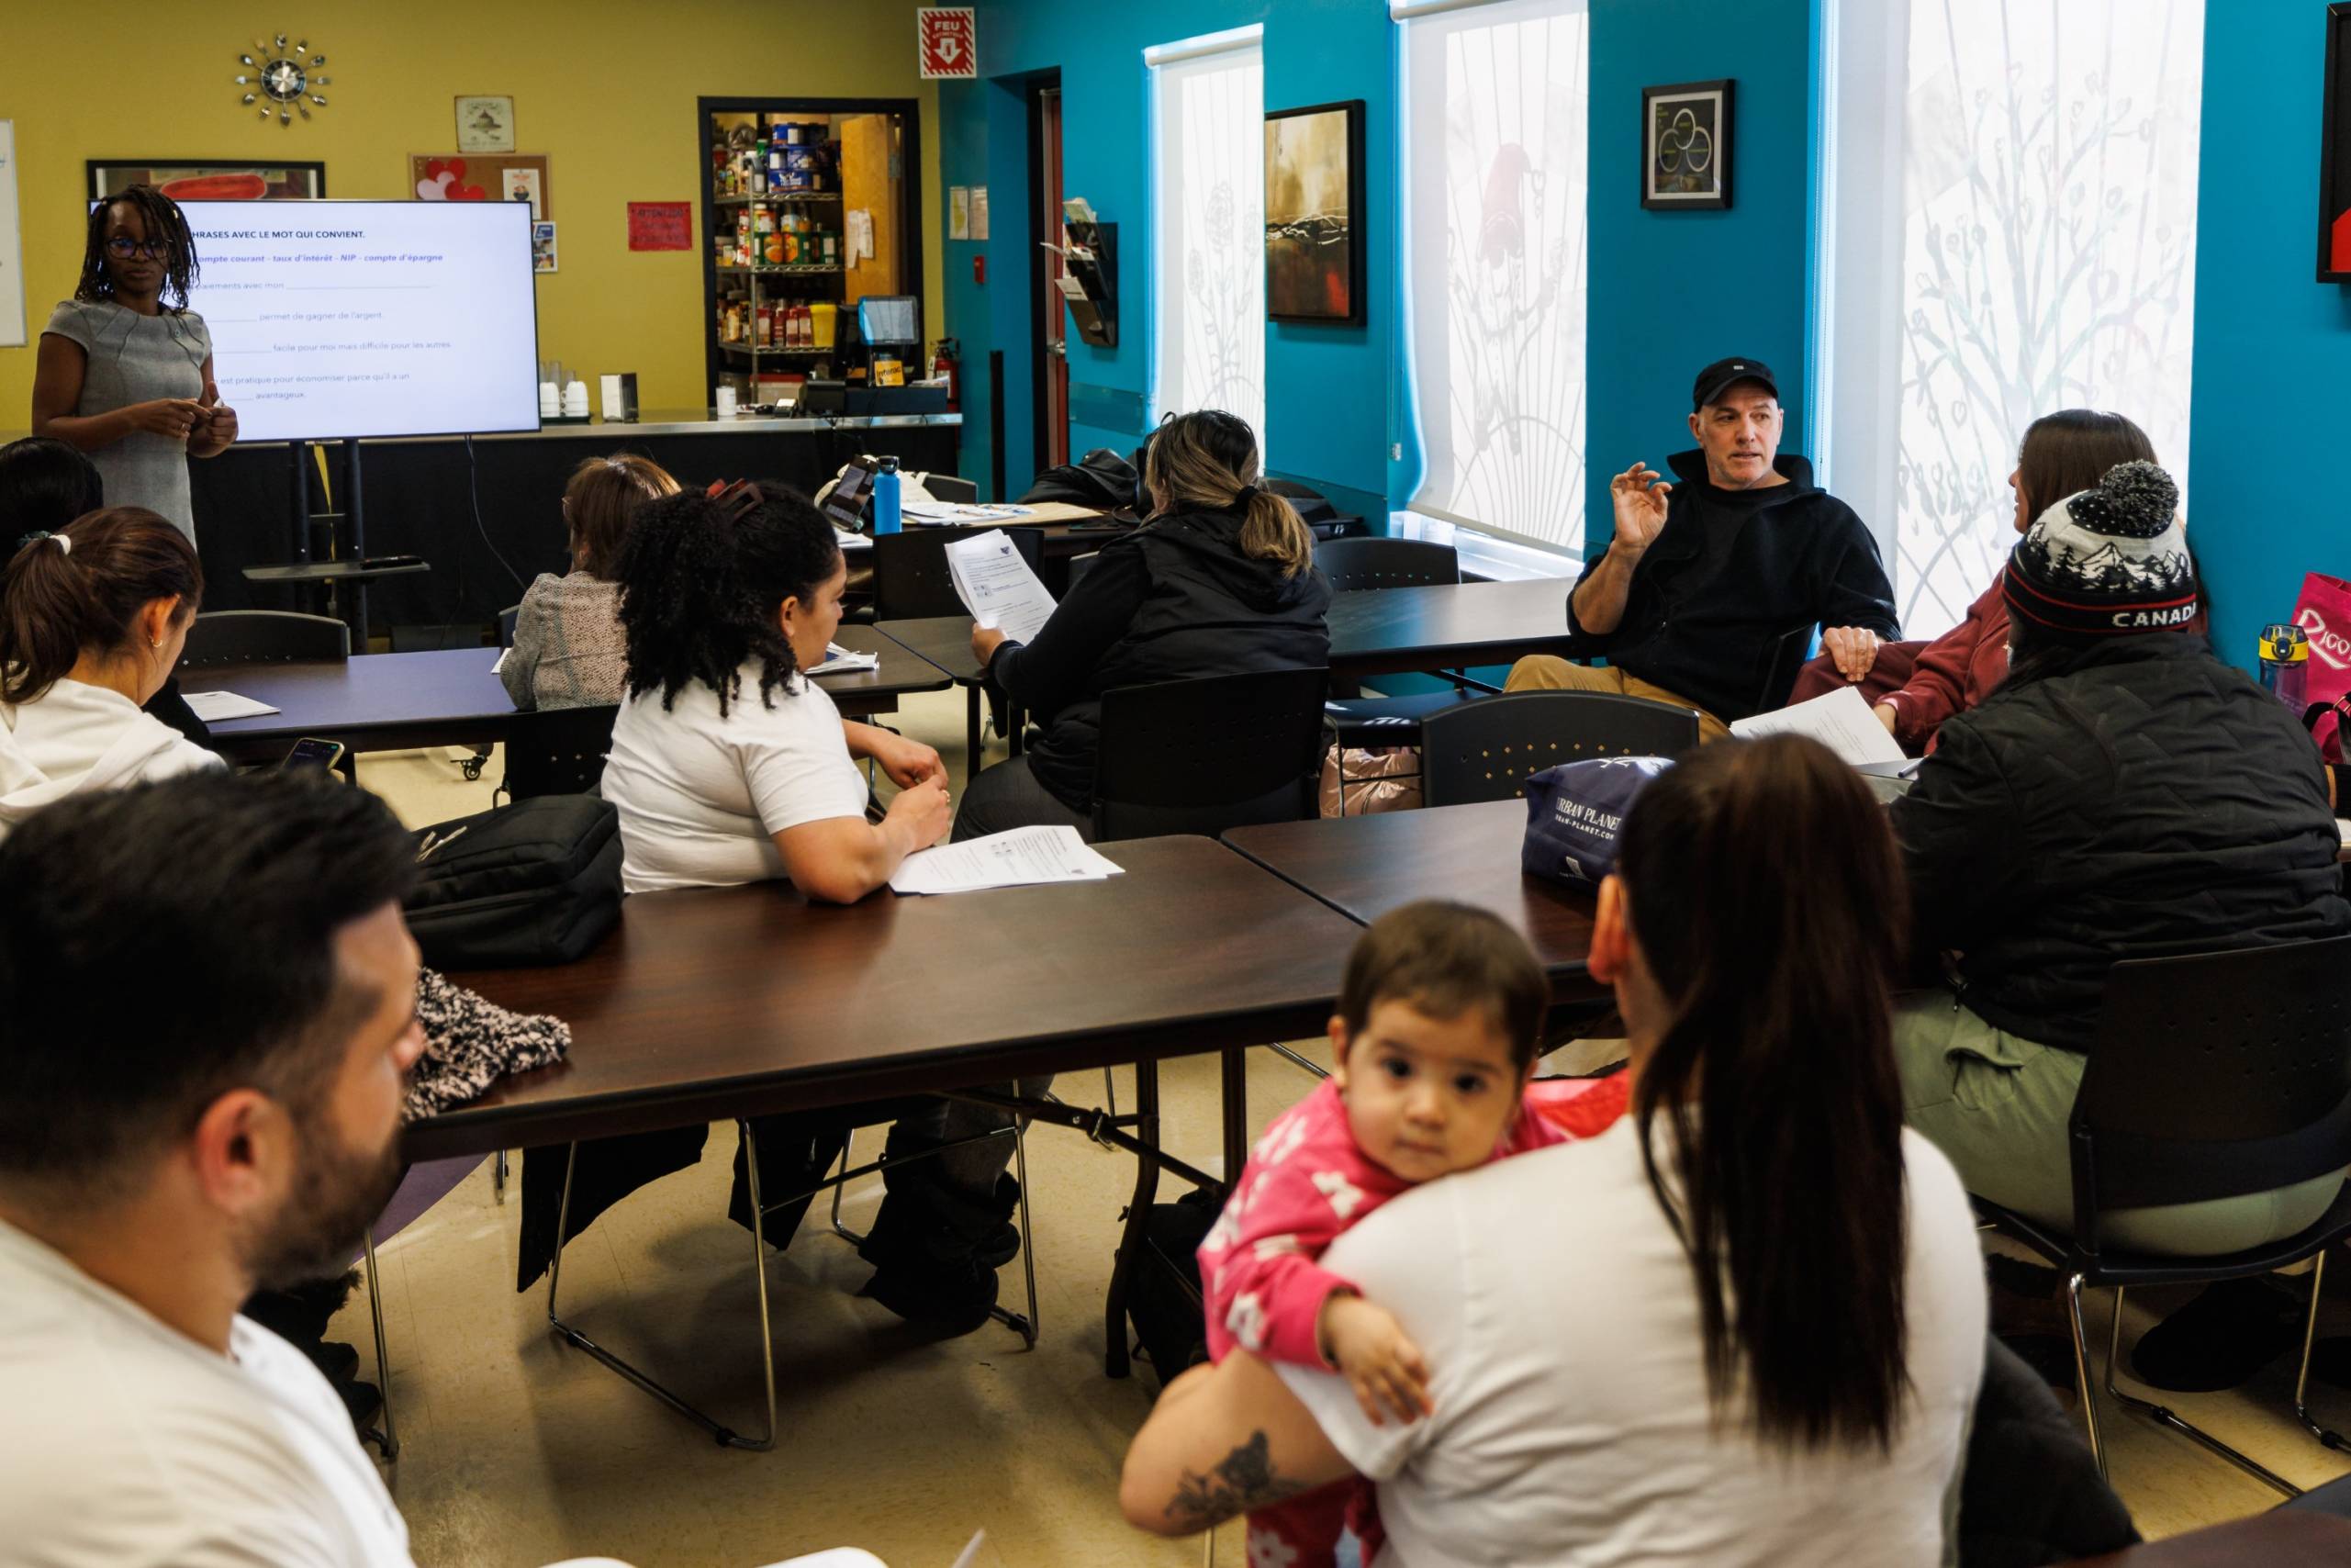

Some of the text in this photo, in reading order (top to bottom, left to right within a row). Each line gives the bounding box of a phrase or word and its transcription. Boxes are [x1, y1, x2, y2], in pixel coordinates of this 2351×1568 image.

[935, 21, 959, 30] FEU
[191, 230, 365, 239] HRASES AVEC LE MOT QUI CONVIENT.
[196, 255, 229, 263] ompte
[340, 253, 356, 262] NIP
[364, 254, 397, 263] compte
[259, 312, 290, 321] permet
[292, 311, 304, 319] de
[306, 312, 336, 321] gagner
[273, 343, 296, 352] facile
[297, 344, 318, 353] pour
[390, 342, 410, 352] pour
[412, 341, 424, 349] les
[235, 375, 271, 386] pratique
[274, 375, 294, 385] pour
[347, 374, 371, 383] parce
